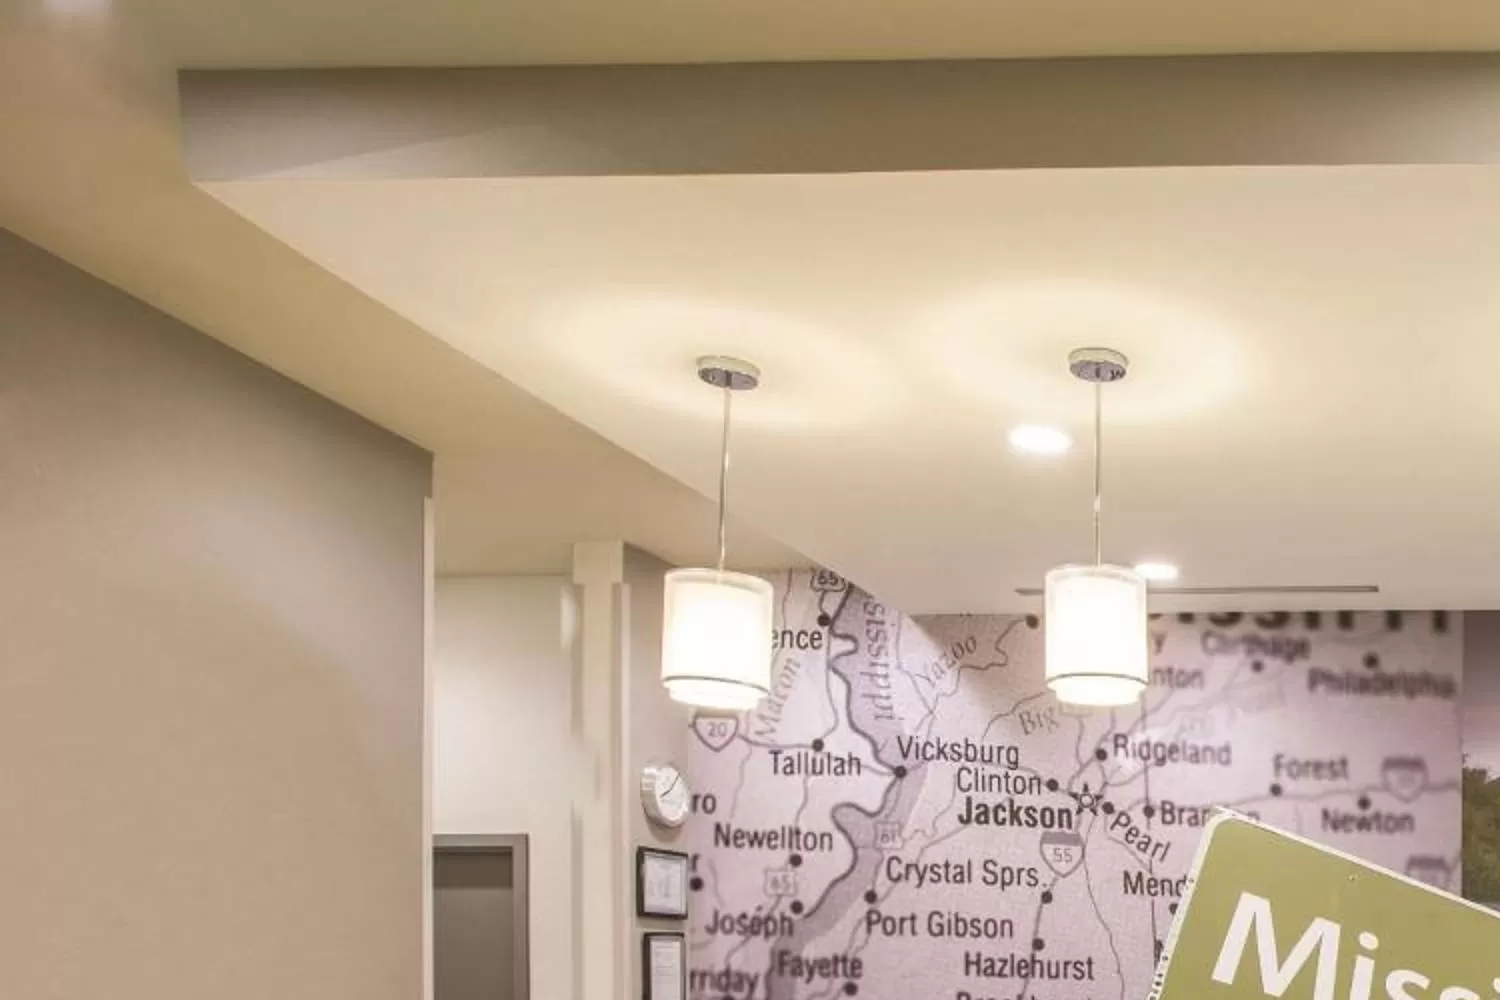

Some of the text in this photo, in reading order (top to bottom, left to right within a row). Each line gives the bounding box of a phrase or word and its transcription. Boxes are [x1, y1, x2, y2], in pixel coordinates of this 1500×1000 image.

[1149, 667, 1204, 689] nton
[707, 722, 728, 737] 20
[769, 750, 862, 777] Tallulah
[897, 736, 1019, 770] Vicksburg
[1113, 734, 1232, 767] Ridgeland
[957, 767, 1042, 796] Clinton
[1273, 754, 1350, 781] Forest
[958, 801, 1074, 829] Jackson
[1321, 808, 1415, 833] Newton
[714, 821, 833, 852] Newellton
[1110, 811, 1171, 863] Pearl
[1053, 848, 1073, 864] 55
[886, 855, 970, 888] Crystal
[705, 907, 794, 938] Joseph
[866, 910, 1014, 938] Port Gibson
[777, 950, 863, 984] Fayette
[964, 952, 1094, 981] Hazlehurst
